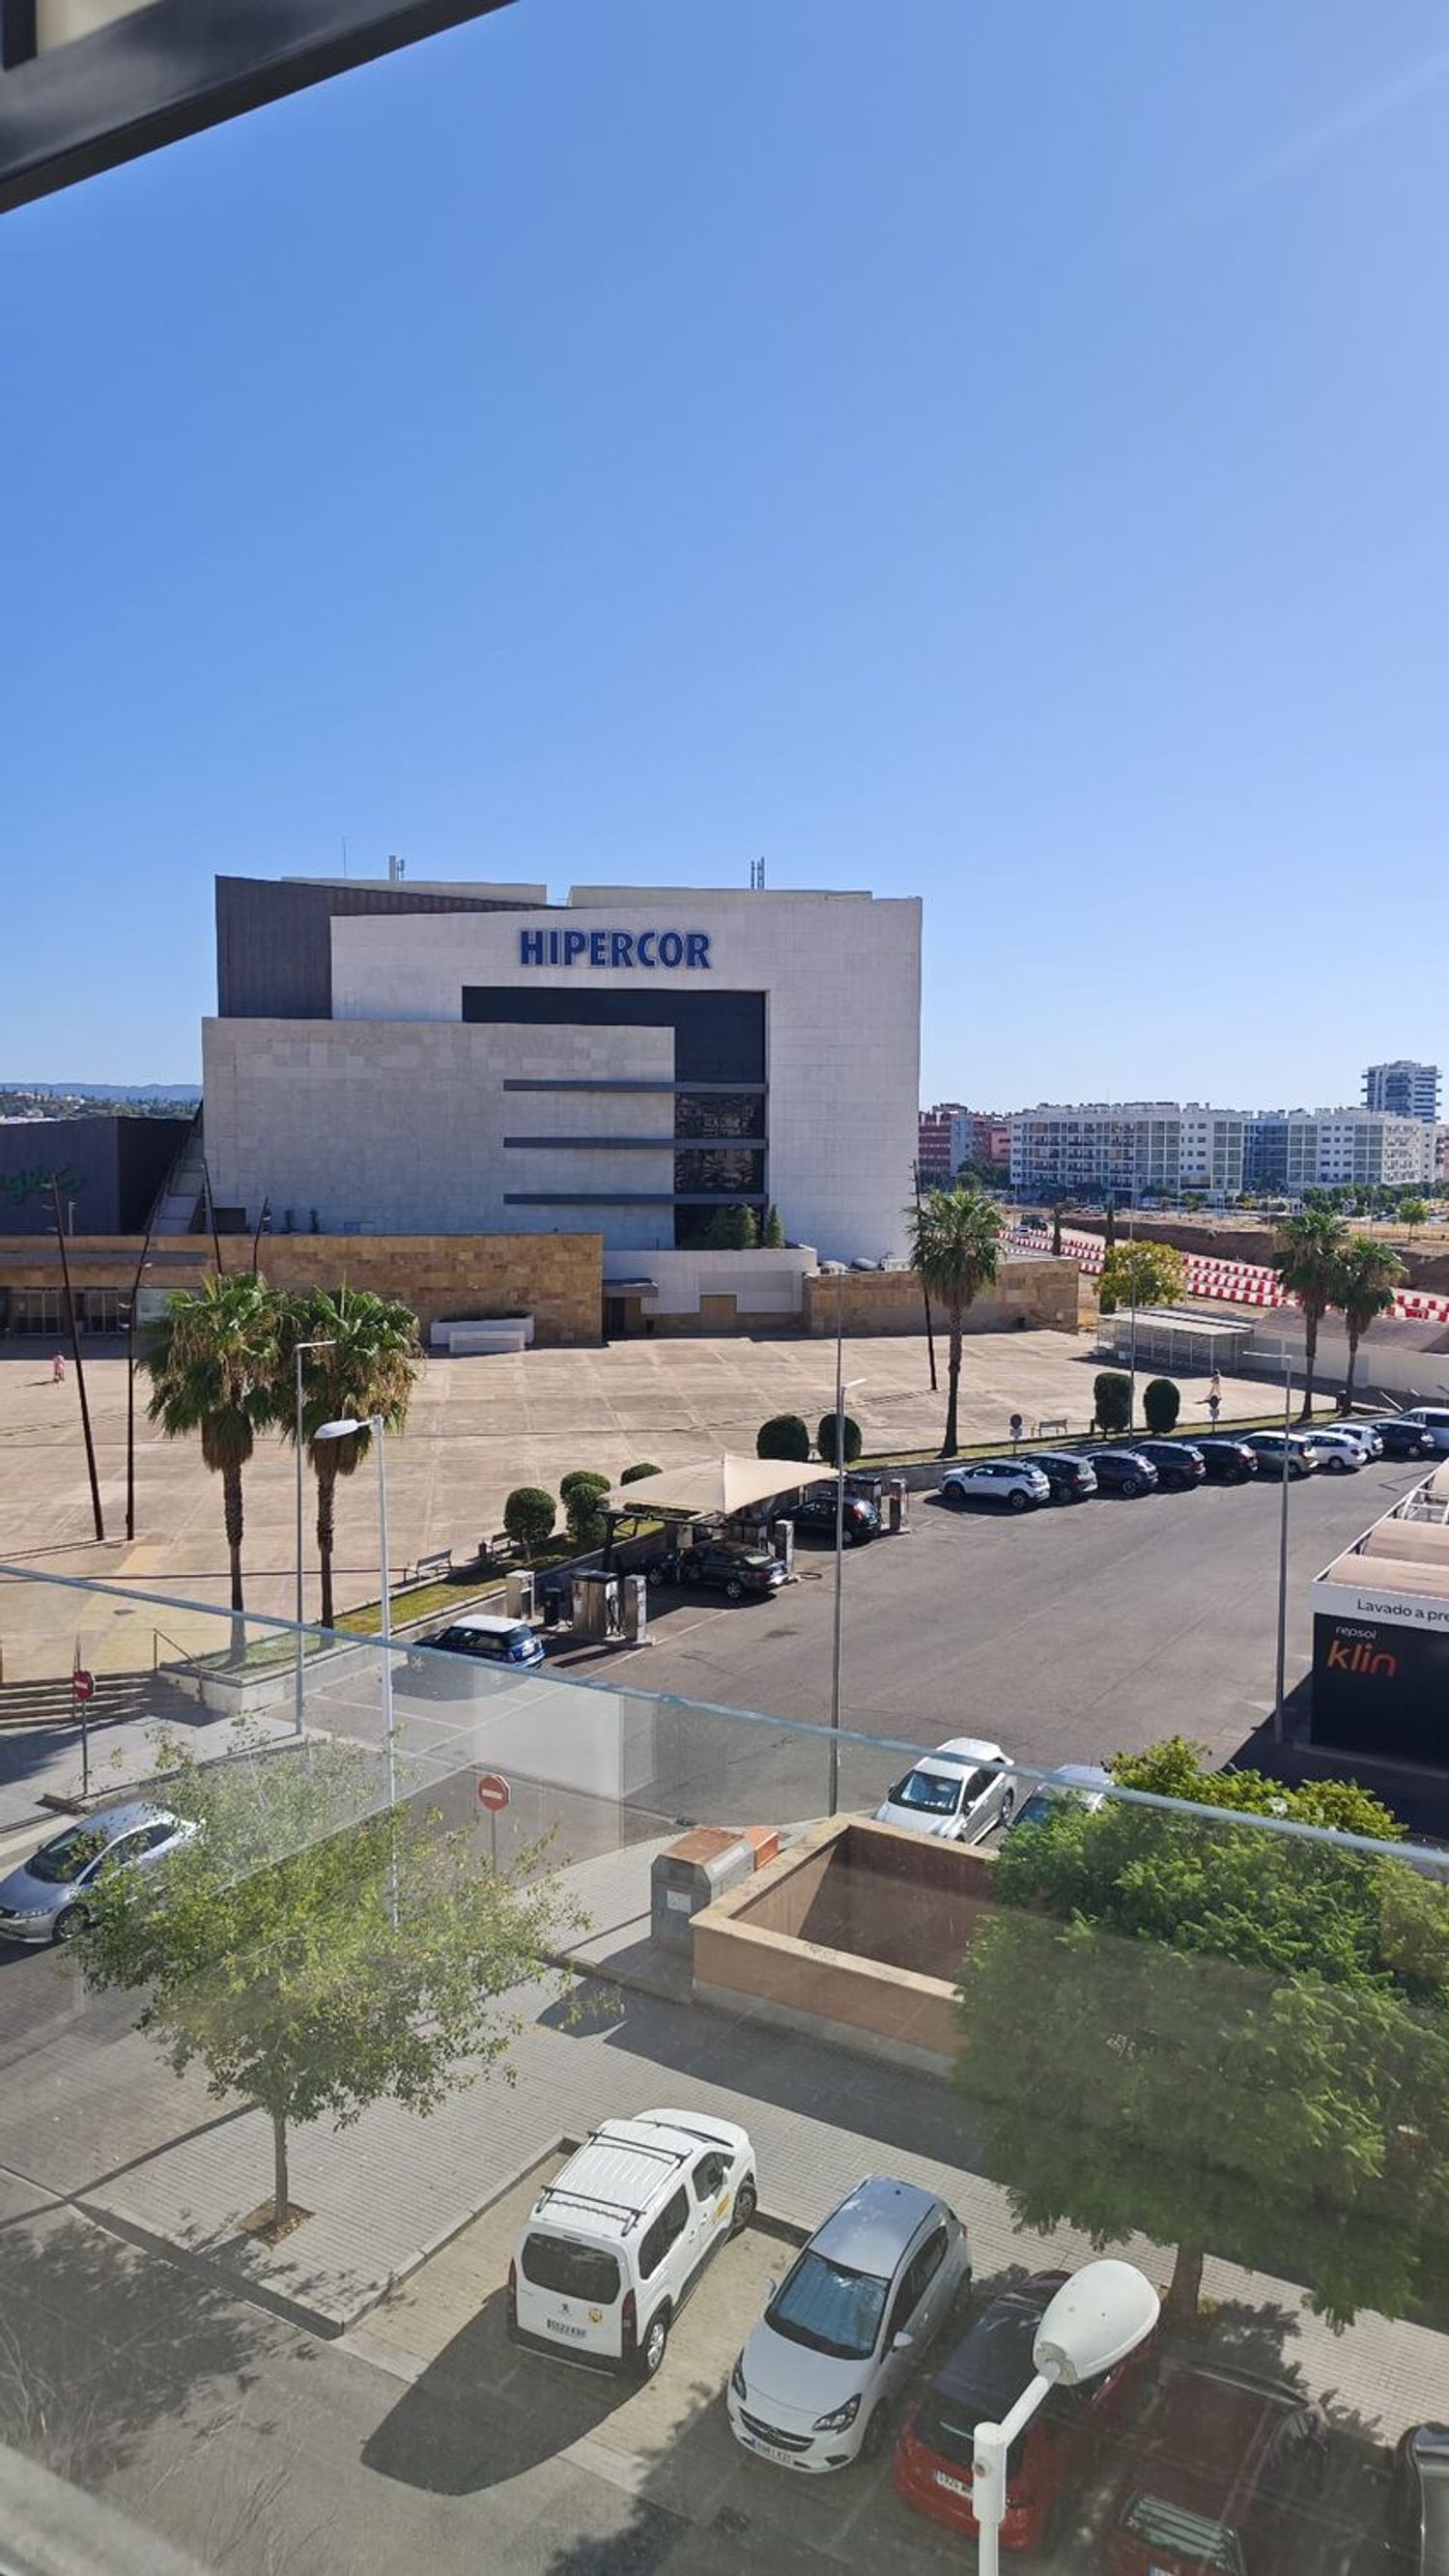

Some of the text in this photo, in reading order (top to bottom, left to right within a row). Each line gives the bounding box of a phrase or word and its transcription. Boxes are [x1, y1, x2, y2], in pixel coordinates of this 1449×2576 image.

[520, 930, 712, 968] HIPERCOR
[1357, 1598, 1412, 1617] Lavado
[1414, 1608, 1425, 1619] a
[1335, 1625, 1377, 1640] repsol
